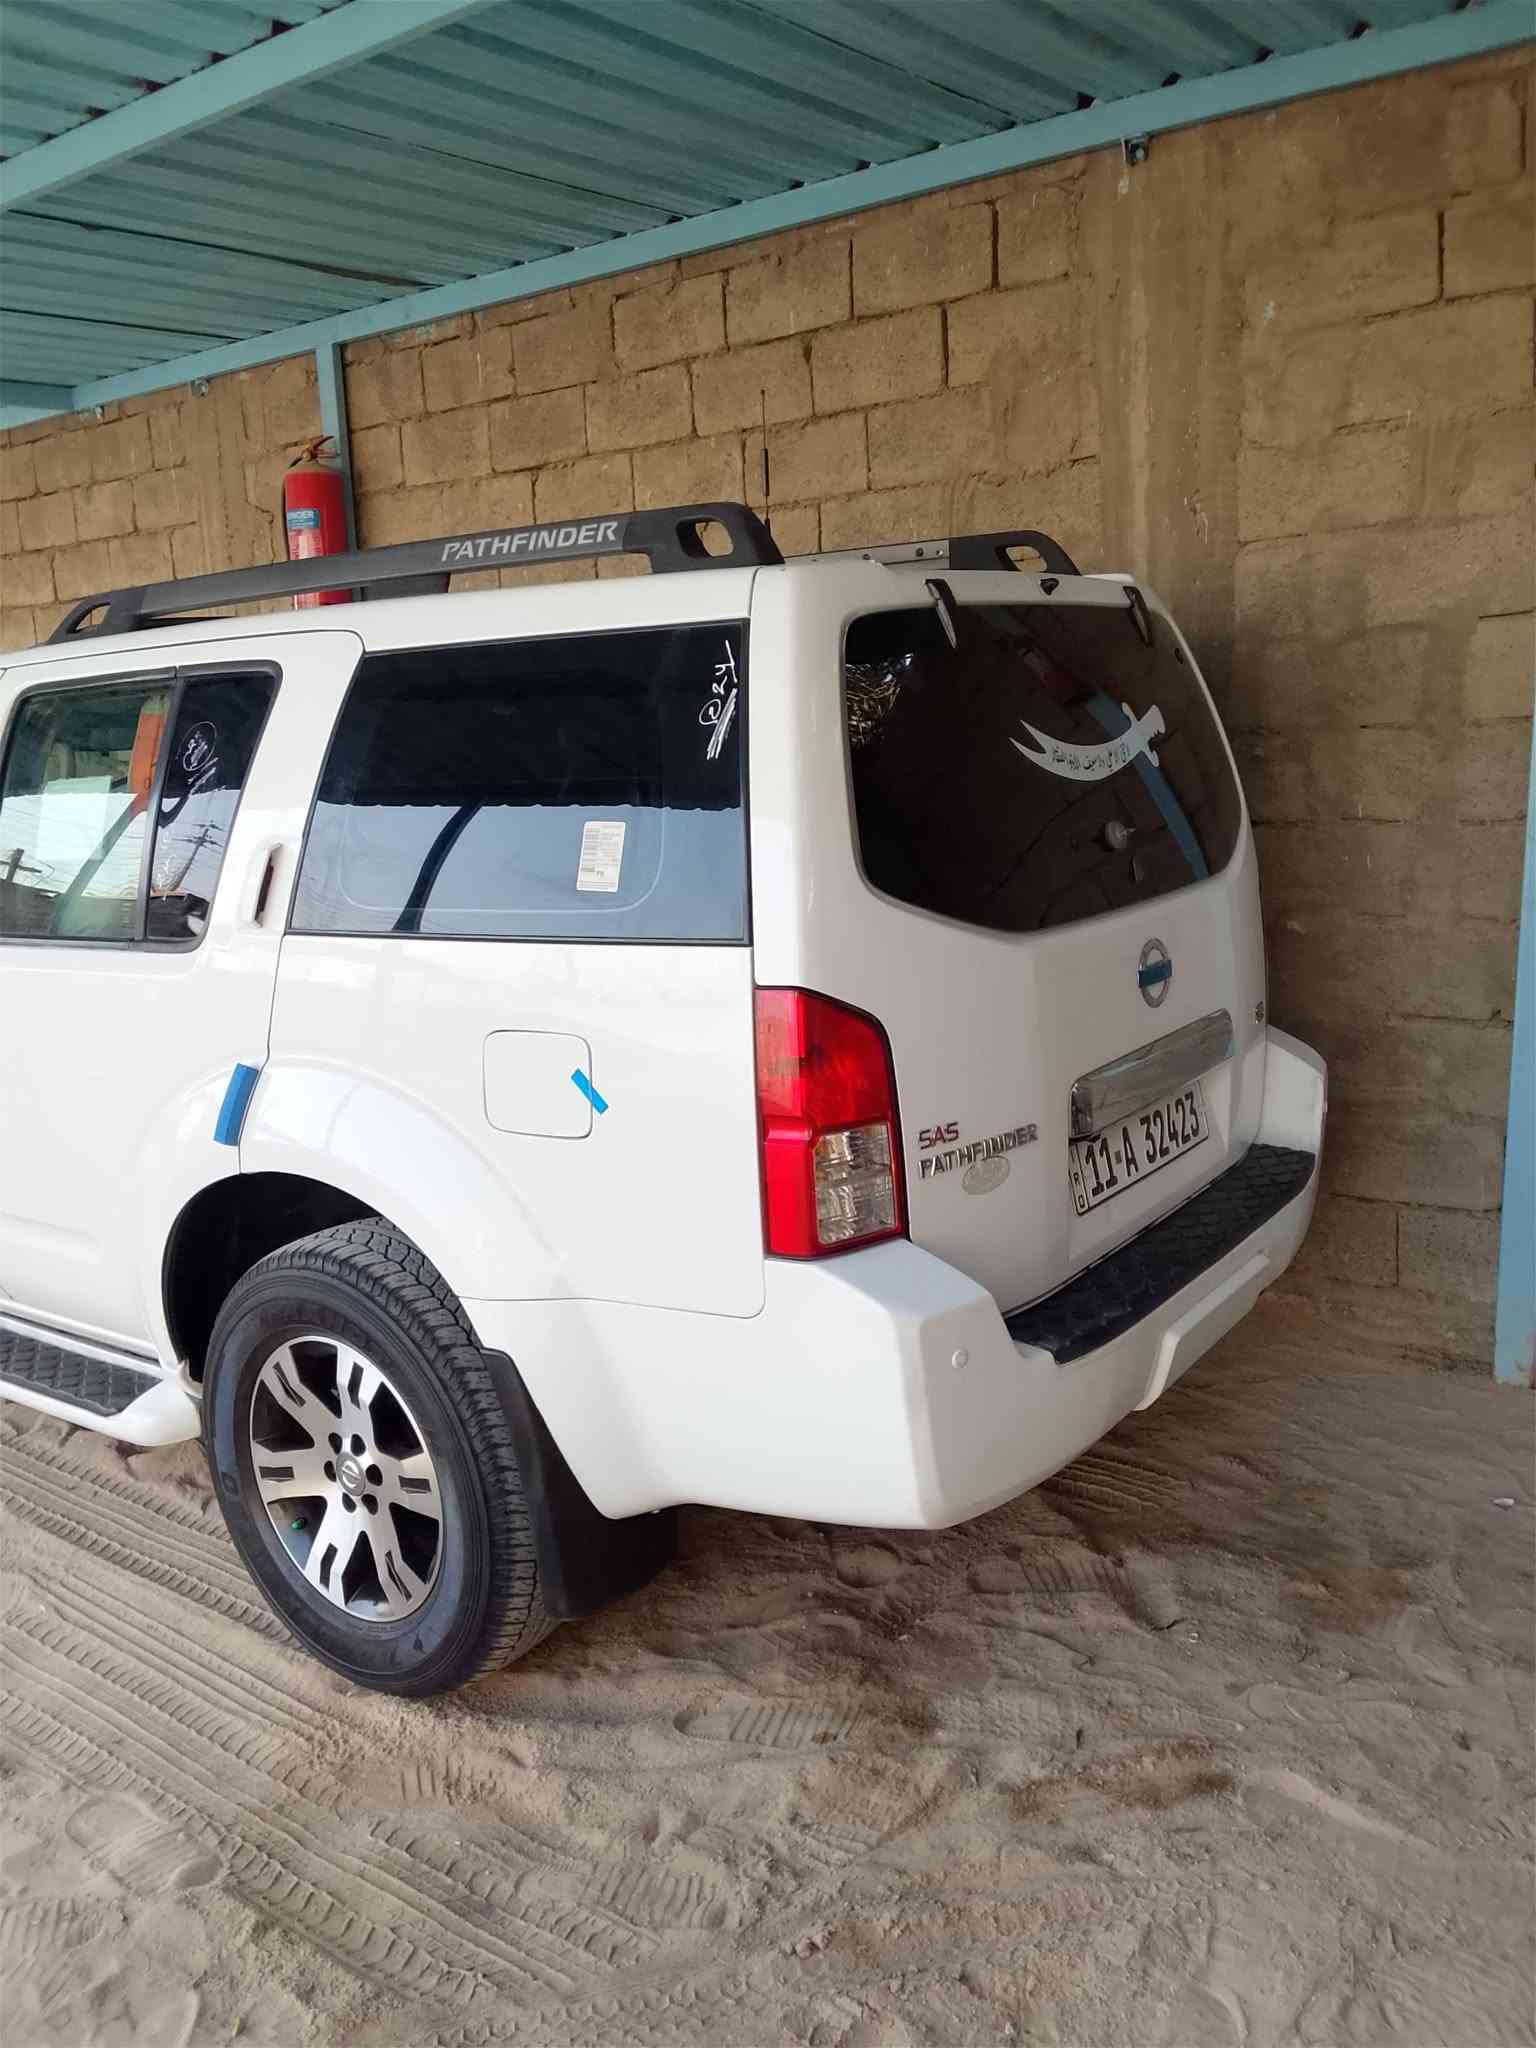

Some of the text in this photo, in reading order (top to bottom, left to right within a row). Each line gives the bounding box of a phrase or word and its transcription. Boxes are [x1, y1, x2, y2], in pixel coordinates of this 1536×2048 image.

[441, 520, 619, 562] PATHFINDER
[918, 1121, 960, 1150] SAS
[919, 1122, 1039, 1179] PATHFINDER
[1139, 1091, 1200, 1164] 32423
